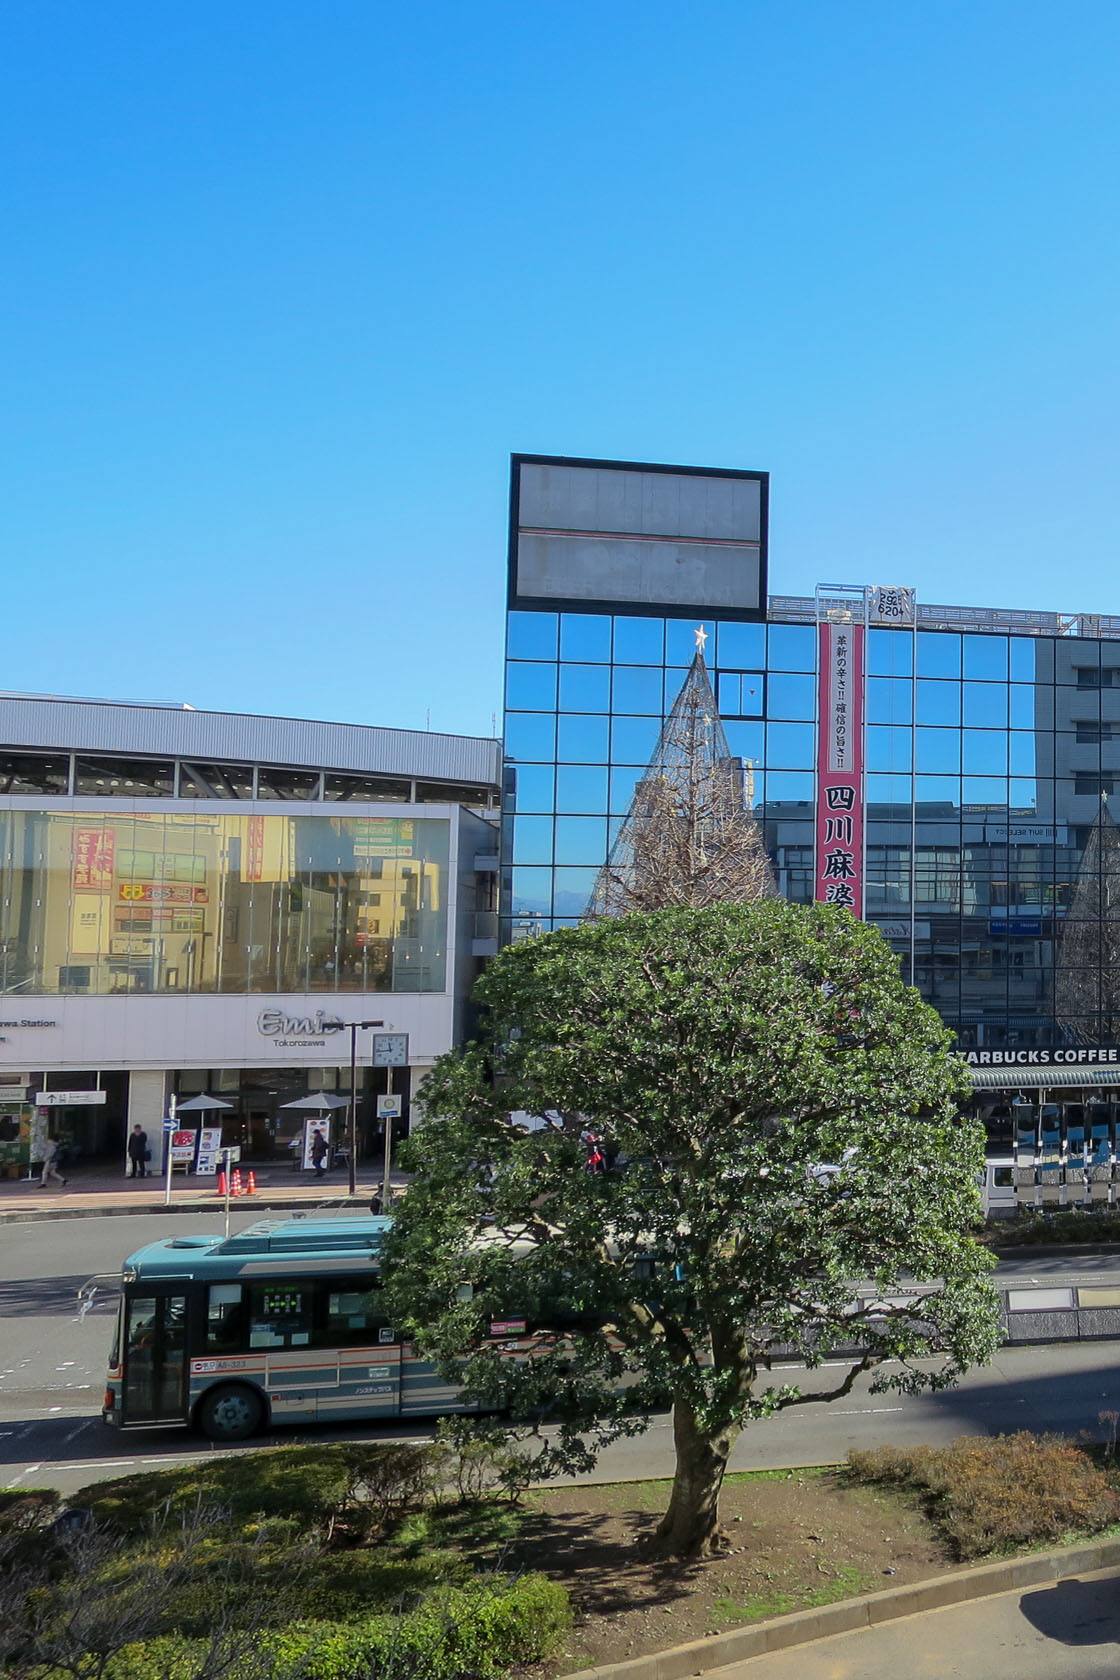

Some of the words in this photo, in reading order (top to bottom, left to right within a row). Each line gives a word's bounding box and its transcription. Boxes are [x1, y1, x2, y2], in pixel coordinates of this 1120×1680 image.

[20, 1019, 56, 1028] Station
[273, 1039, 326, 1048] Tokorozawa
[1053, 1049, 1118, 1062] COFFEE
